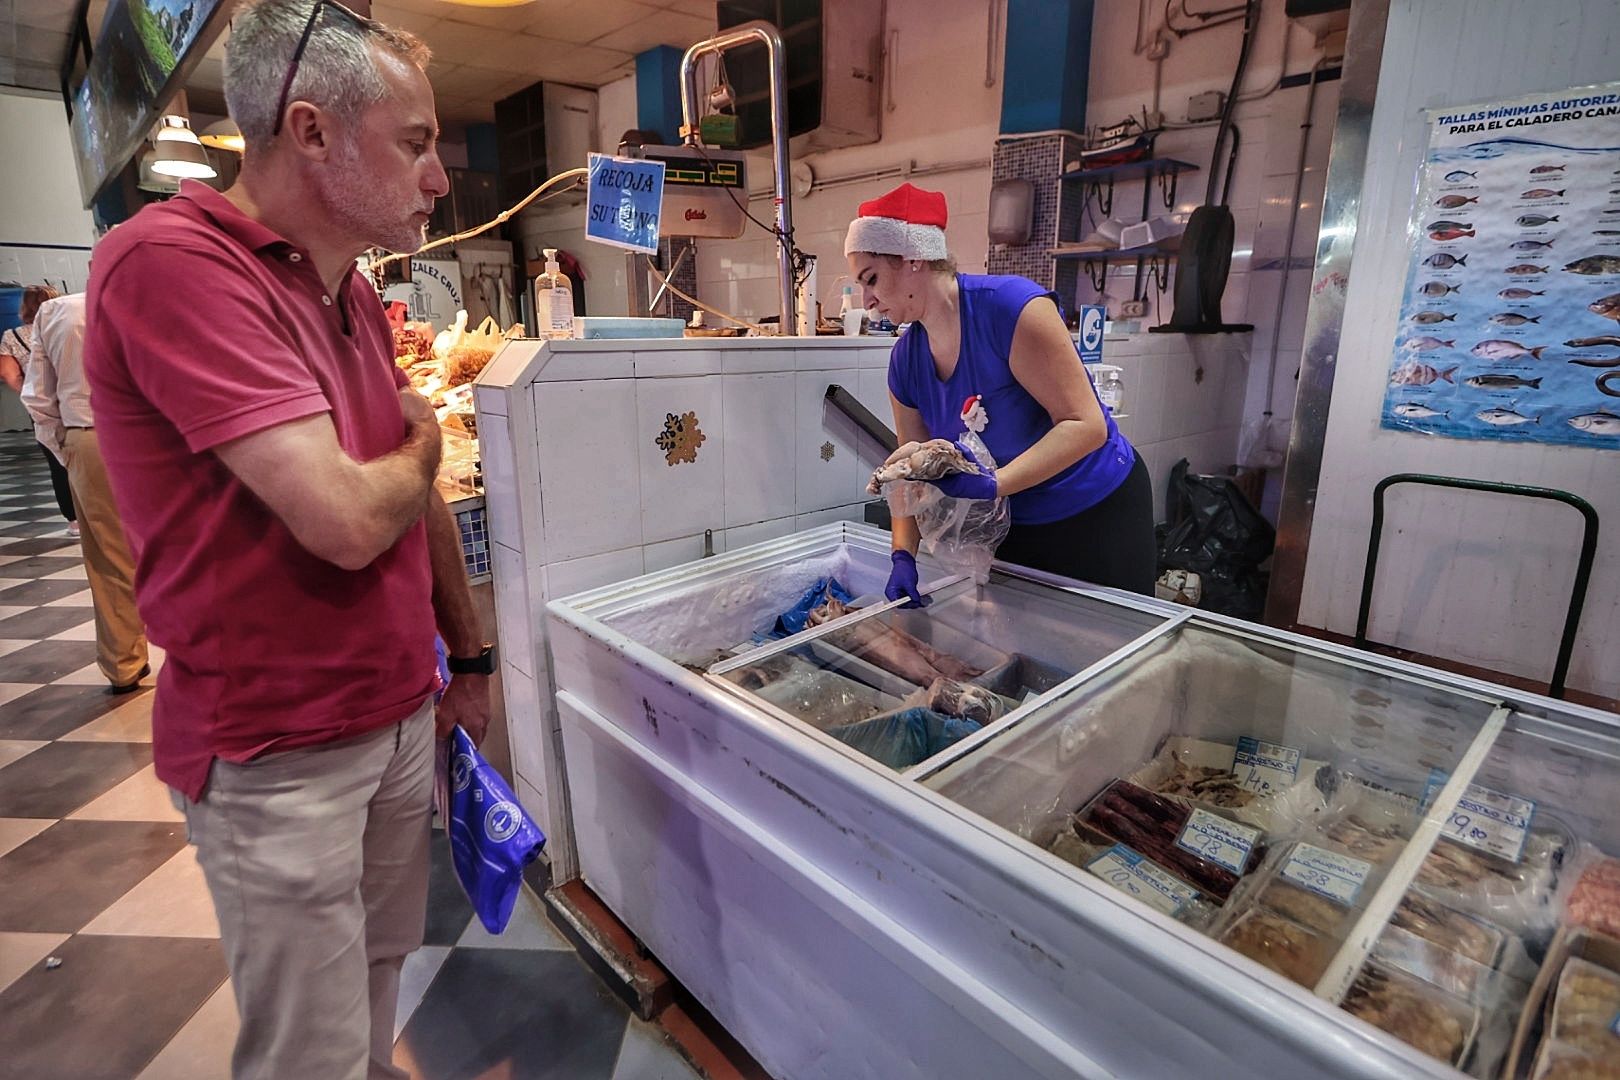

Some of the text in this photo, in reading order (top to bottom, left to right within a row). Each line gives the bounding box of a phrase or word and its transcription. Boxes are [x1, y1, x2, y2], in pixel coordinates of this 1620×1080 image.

[1438, 111, 1486, 126] TALLAS
[1487, 103, 1548, 119] MÍNIMAS
[1449, 122, 1485, 135] PARA
[1488, 118, 1503, 130] EL
[1505, 110, 1582, 128] CALADERO
[598, 168, 654, 192] RECOJA
[591, 203, 658, 230] SU TNO
[440, 275, 461, 307] CRUZ
